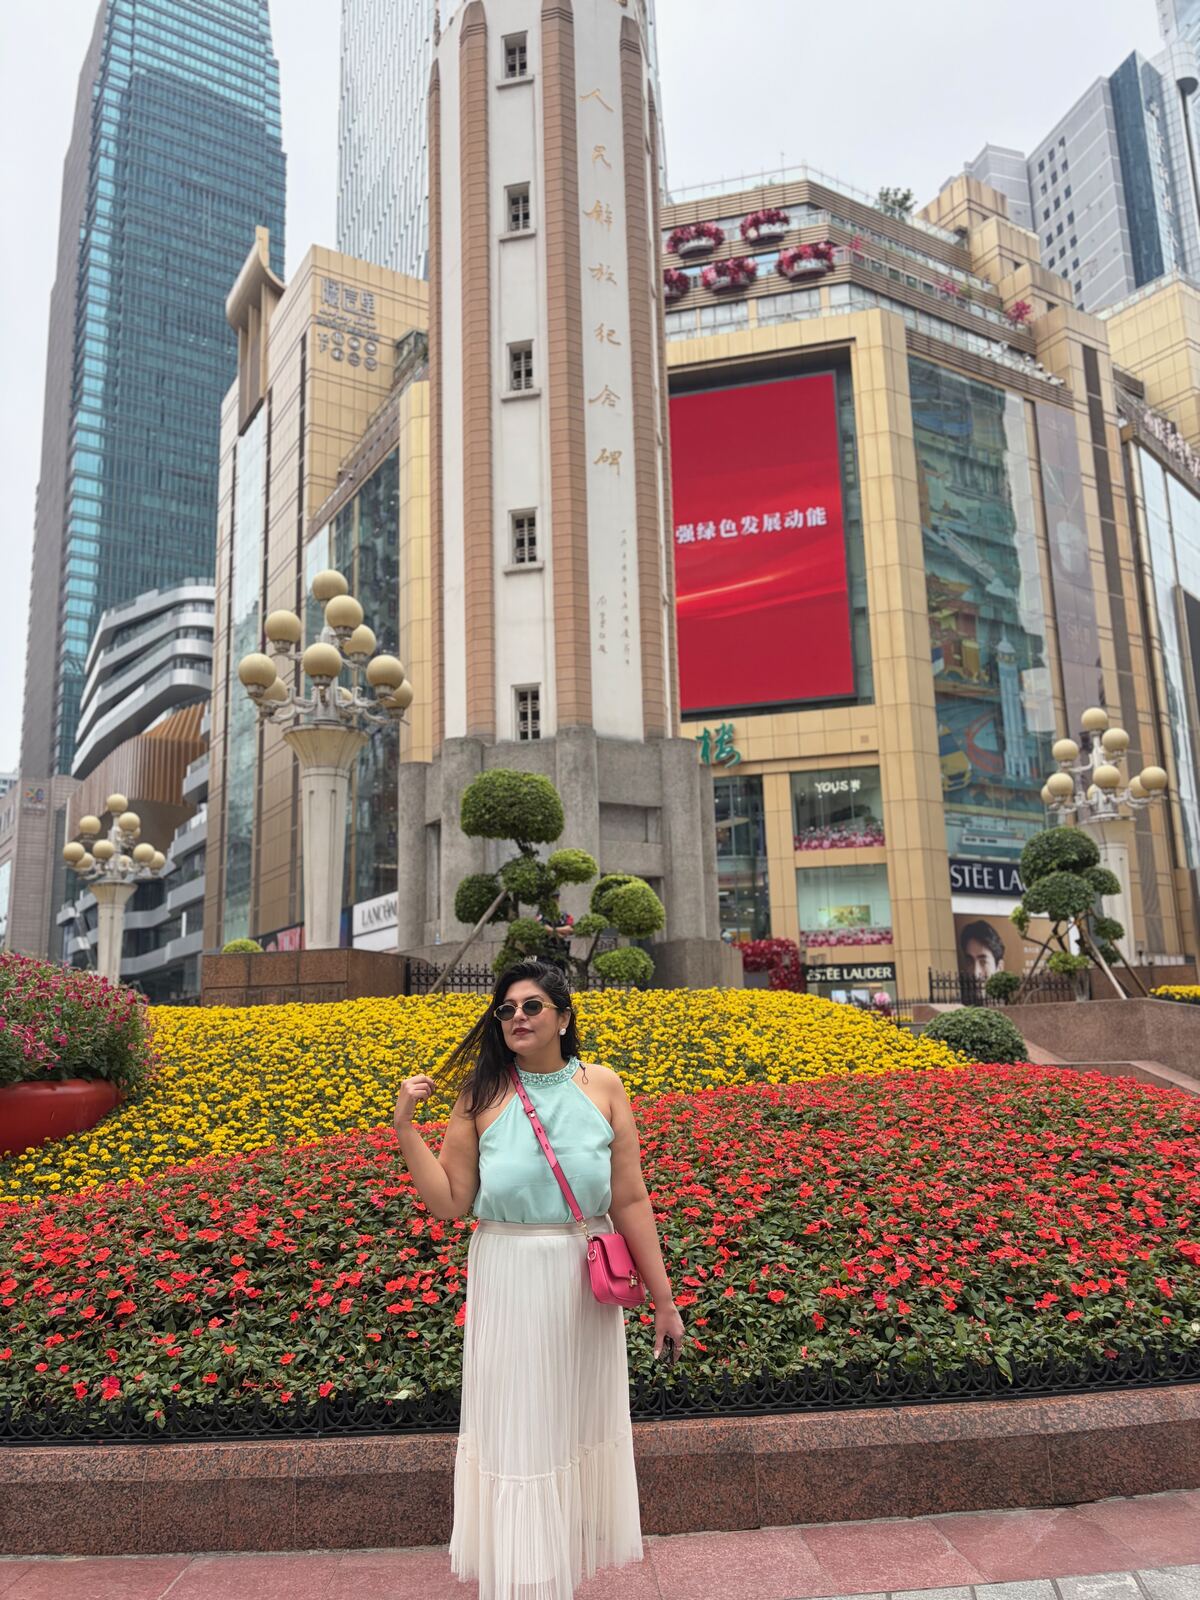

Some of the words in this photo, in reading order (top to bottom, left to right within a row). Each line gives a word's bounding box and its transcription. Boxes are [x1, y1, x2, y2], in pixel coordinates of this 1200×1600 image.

[675, 506, 827, 545] 强绿色发展动能
[998, 868, 1029, 892] LA
[843, 966, 892, 980] LAUDER
